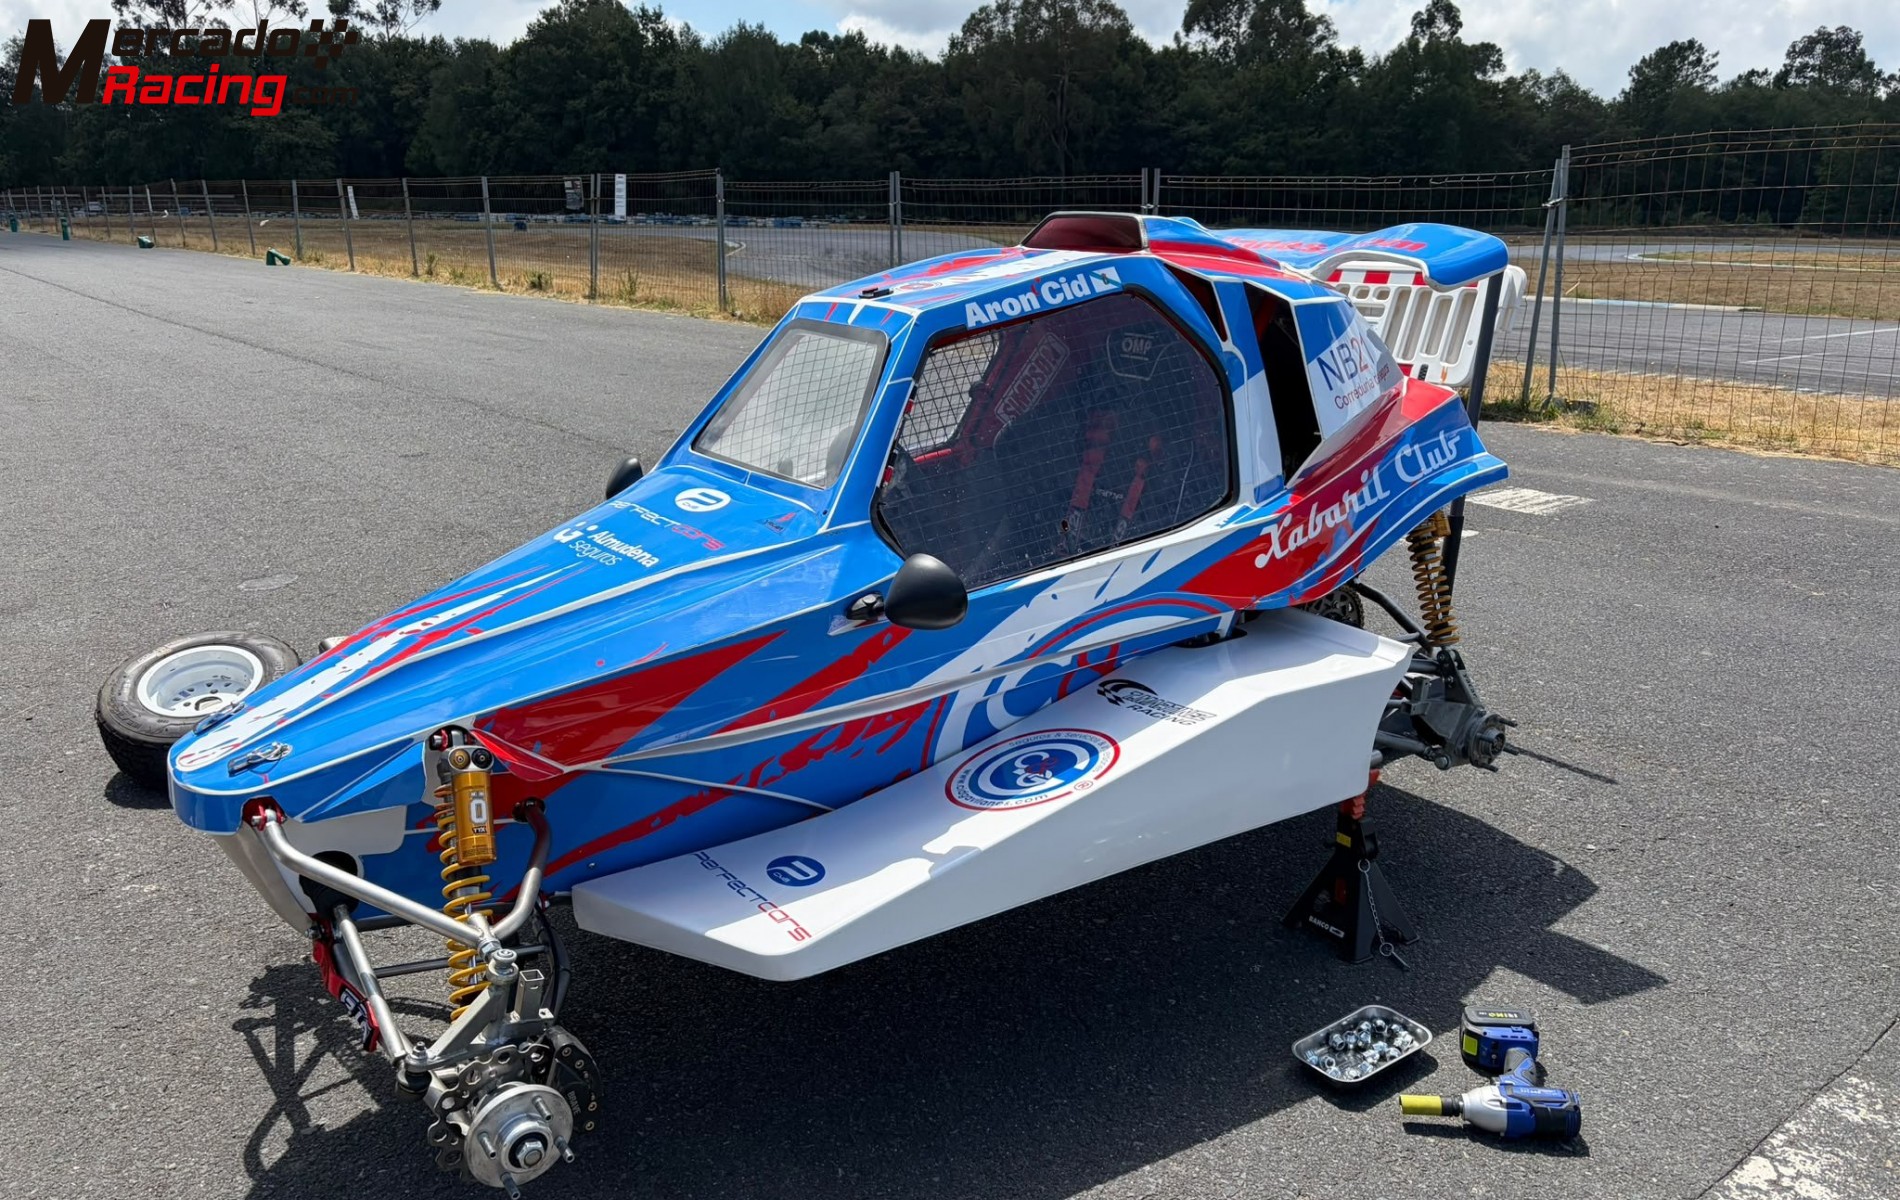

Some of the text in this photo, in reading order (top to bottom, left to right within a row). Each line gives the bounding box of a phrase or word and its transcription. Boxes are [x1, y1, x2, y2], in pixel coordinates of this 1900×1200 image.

[965, 273, 1092, 330] Aron Cid
[1121, 336, 1153, 356] OMP
[1394, 430, 1461, 483] Club
[568, 539, 623, 566] seguros
[588, 530, 660, 568] Almudena
[1126, 704, 1197, 726] RACING
